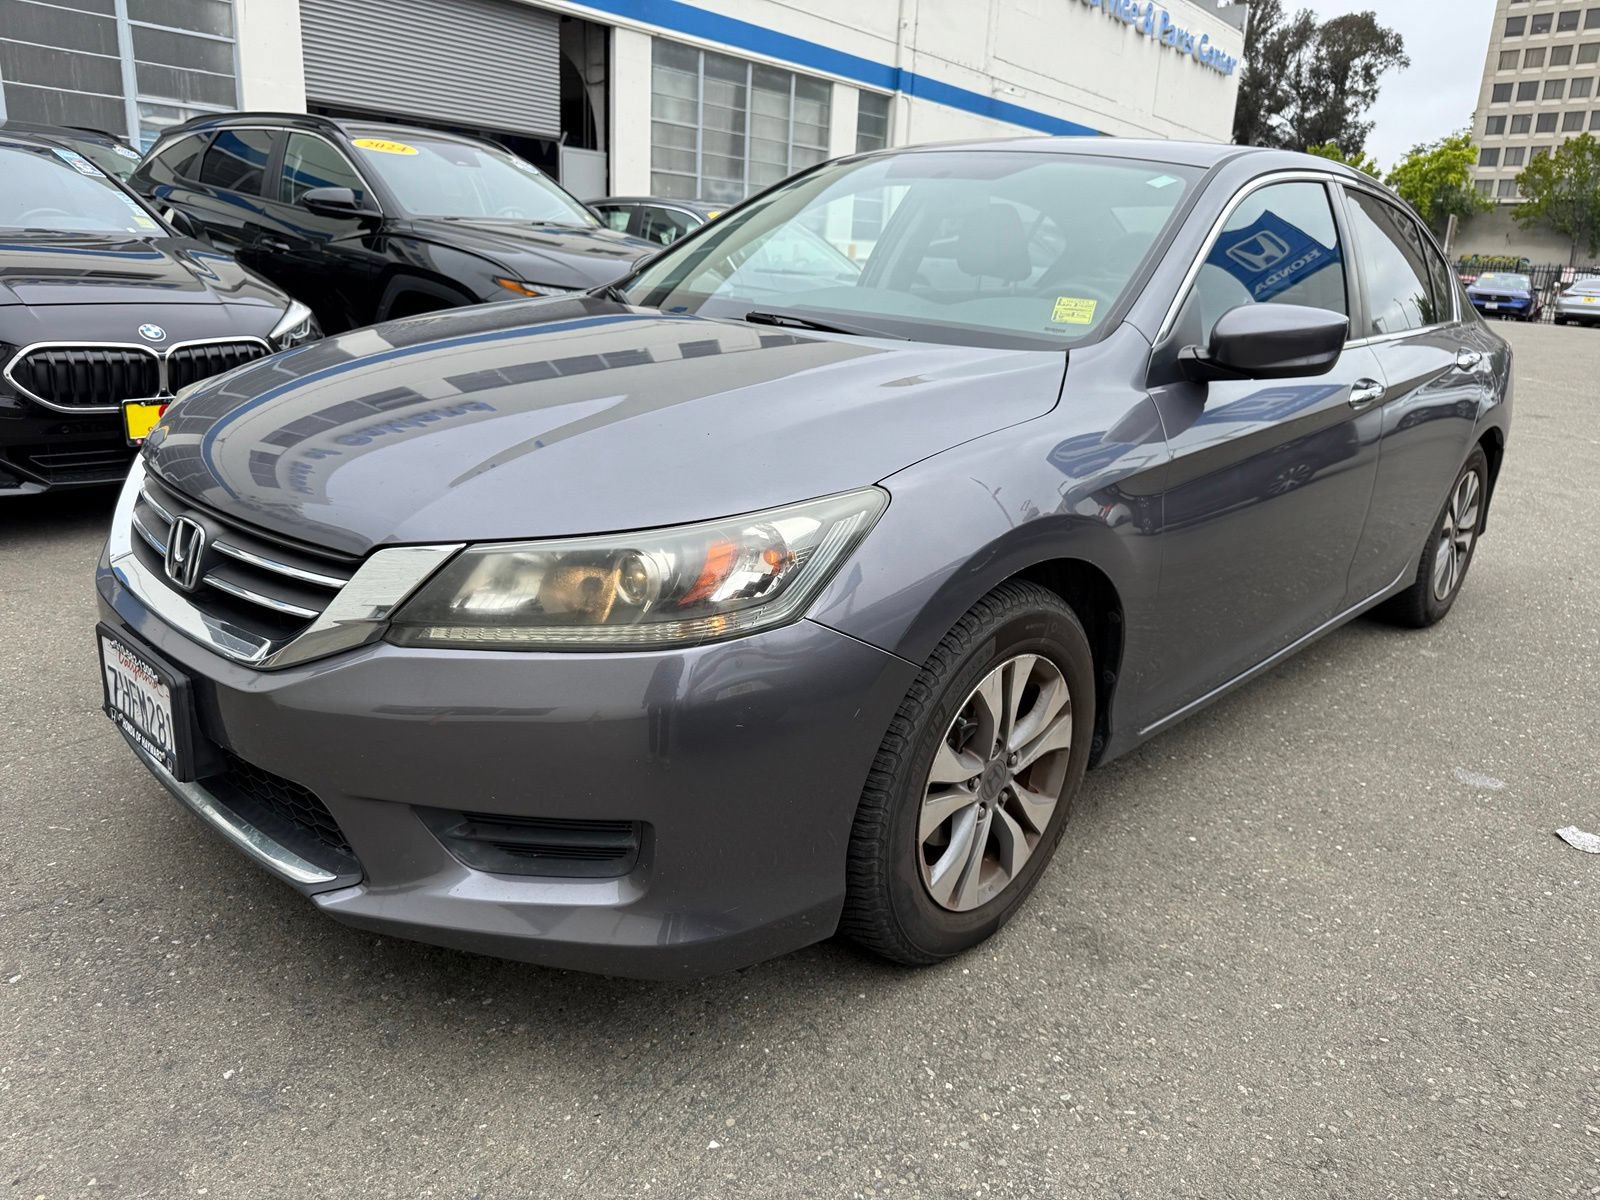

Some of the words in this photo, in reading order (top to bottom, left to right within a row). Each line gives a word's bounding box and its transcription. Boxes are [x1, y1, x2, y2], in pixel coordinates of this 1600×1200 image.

[1138, 2, 1153, 35] &
[1153, 9, 1195, 54] Parts
[1195, 33, 1237, 75] Center
[364, 141, 408, 152] 2024
